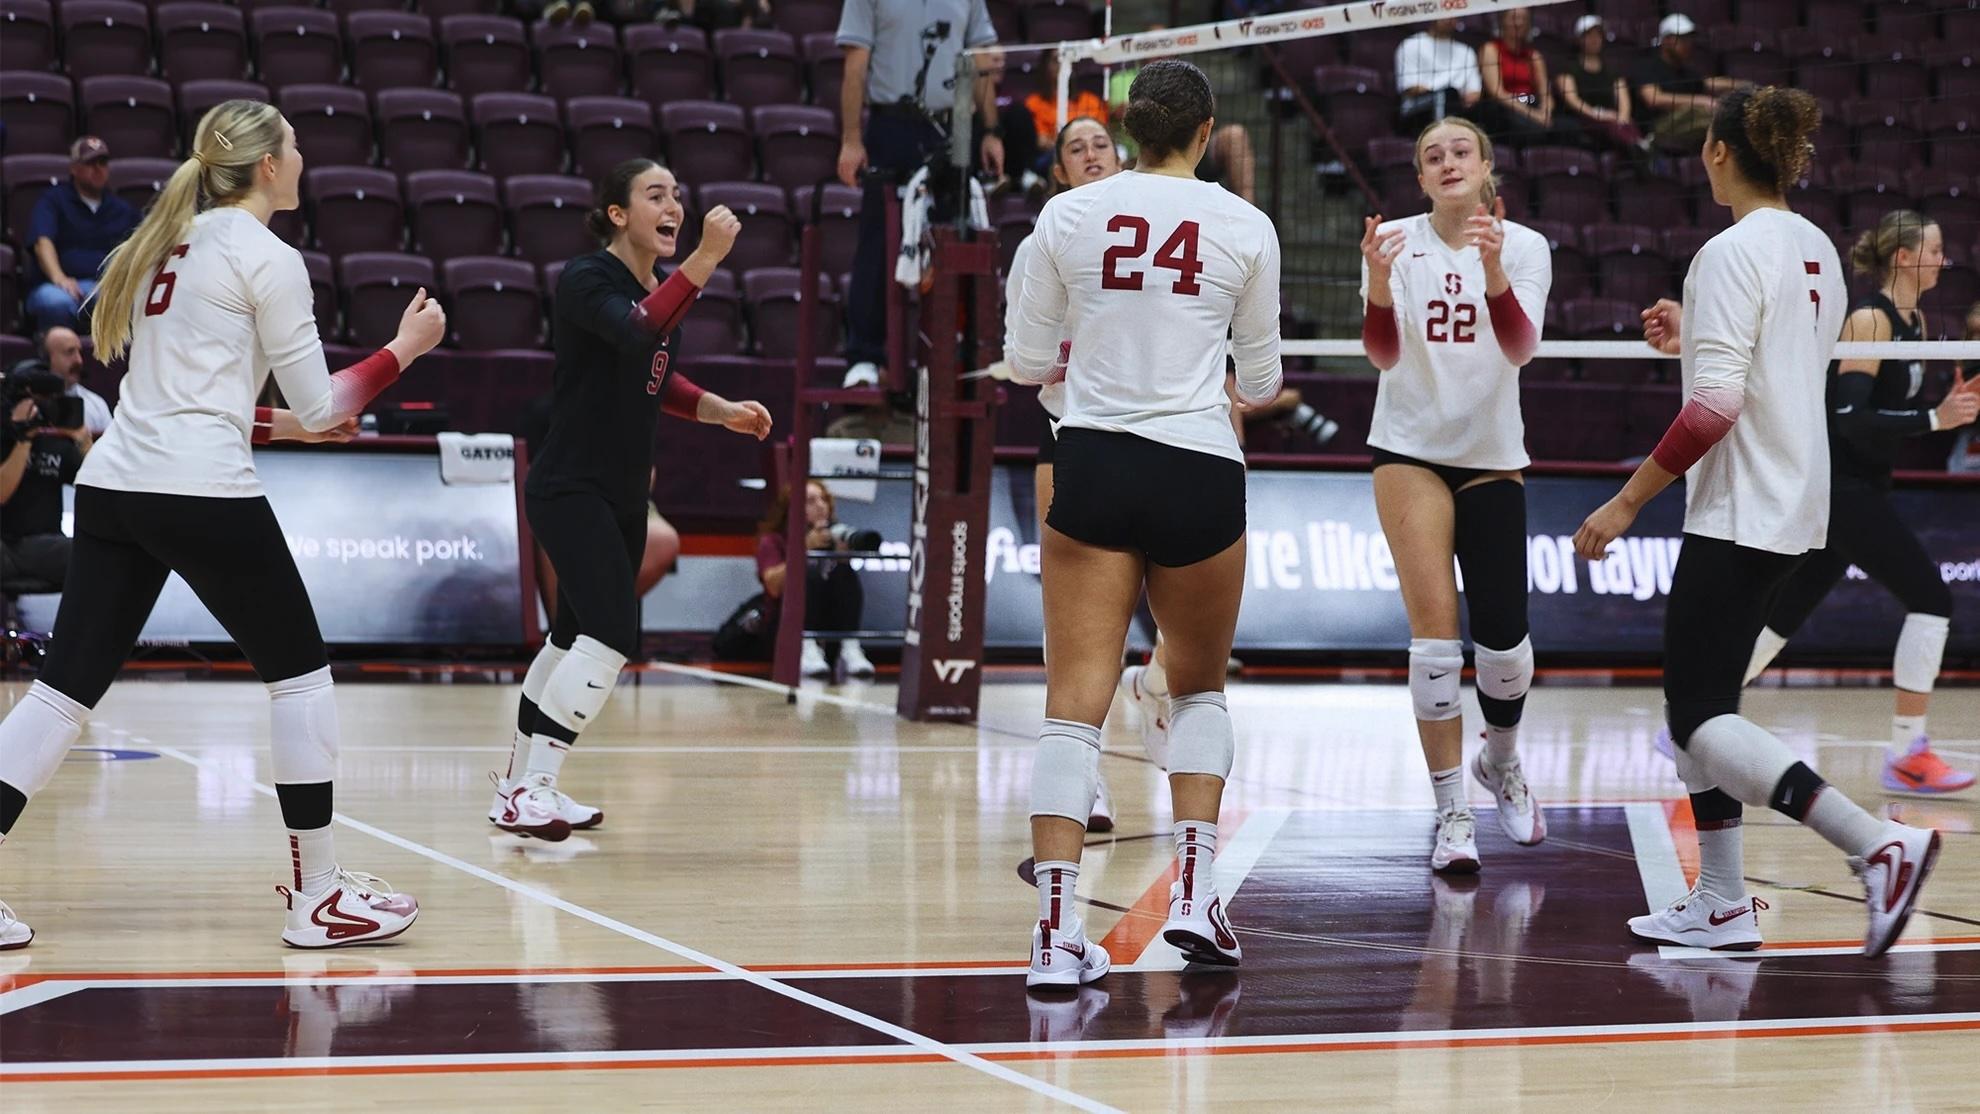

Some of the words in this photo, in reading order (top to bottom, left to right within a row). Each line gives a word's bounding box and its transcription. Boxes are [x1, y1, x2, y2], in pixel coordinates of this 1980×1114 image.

[144, 243, 191, 317] 6
[1101, 214, 1203, 297] 24
[1426, 299, 1477, 343] 22
[646, 350, 670, 395] 9
[325, 535, 411, 565] speak
[415, 535, 484, 566] pork.
[951, 520, 969, 576] sports
[1305, 518, 1401, 592] like
[947, 575, 966, 642] imports
[932, 659, 976, 684] VT
